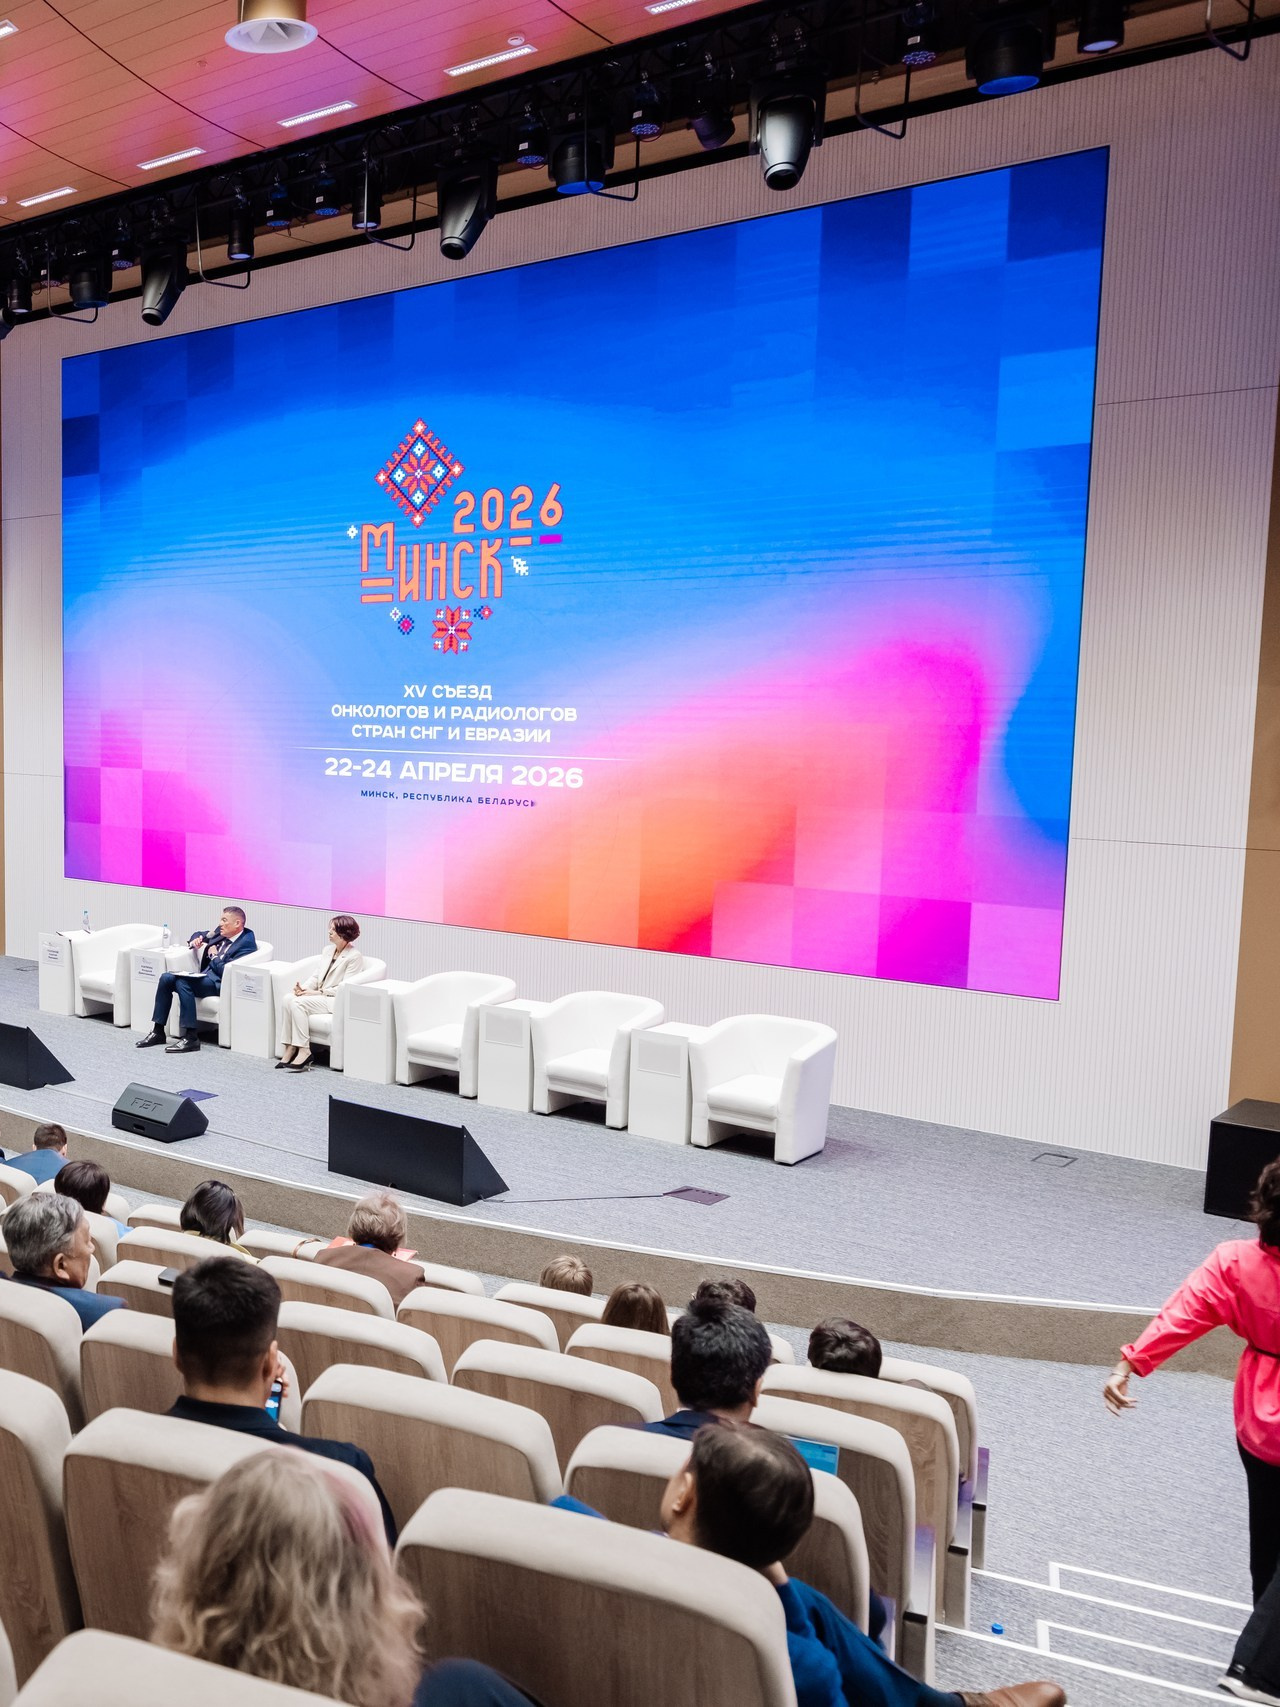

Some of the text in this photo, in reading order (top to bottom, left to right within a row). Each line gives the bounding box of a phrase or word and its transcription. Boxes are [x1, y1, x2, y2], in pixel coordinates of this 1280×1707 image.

[452, 482, 563, 534] 2026
[403, 684, 492, 701] XV СЪЕЗД
[331, 704, 577, 722] ОНКОЛОГОВ И РАДИОЛОГОВ
[351, 724, 551, 743] СТРАН СНГ И ЕВРАЗИИ
[324, 757, 584, 789] 22-24 АПРЕЛЯ 2026
[360, 789, 399, 800] МИНСК,
[402, 792, 473, 804] РЕСПУБЛИКА
